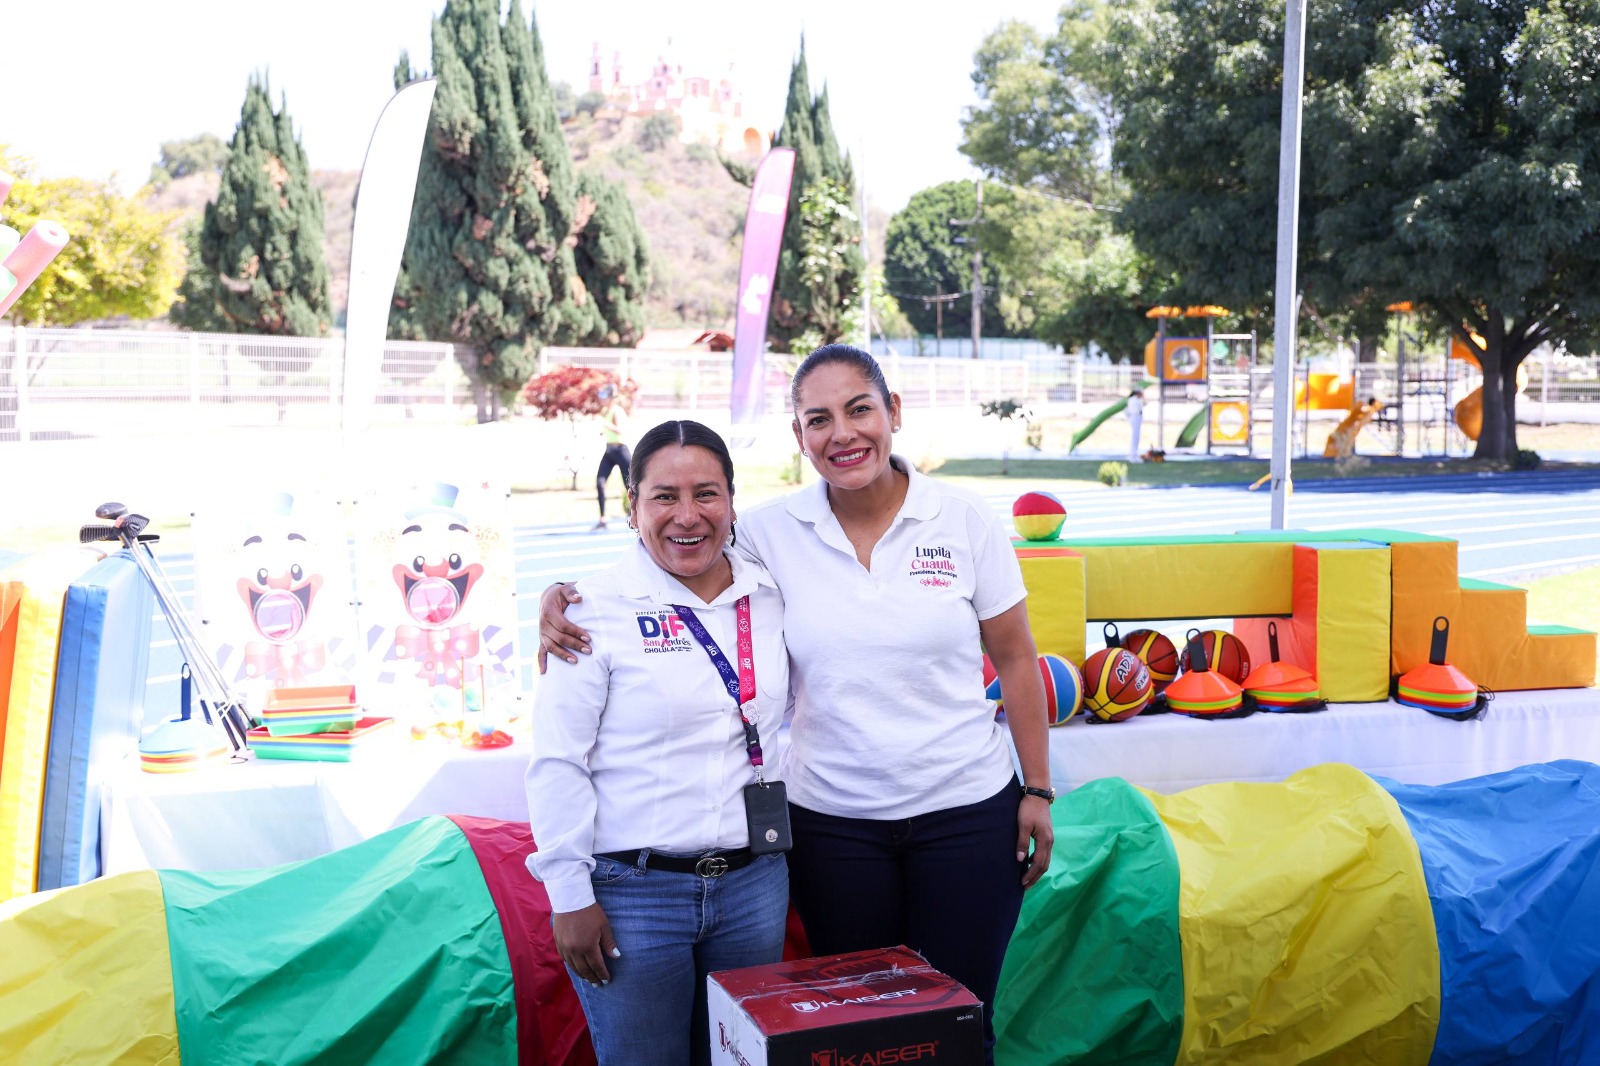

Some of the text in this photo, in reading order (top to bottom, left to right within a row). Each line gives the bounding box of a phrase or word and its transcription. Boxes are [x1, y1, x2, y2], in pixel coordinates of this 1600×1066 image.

[915, 546, 951, 559] Lupita
[911, 559, 955, 571] Cuautle
[642, 638, 660, 647] San
[819, 988, 917, 1008] KAISER
[839, 1042, 937, 1066] KAISER
